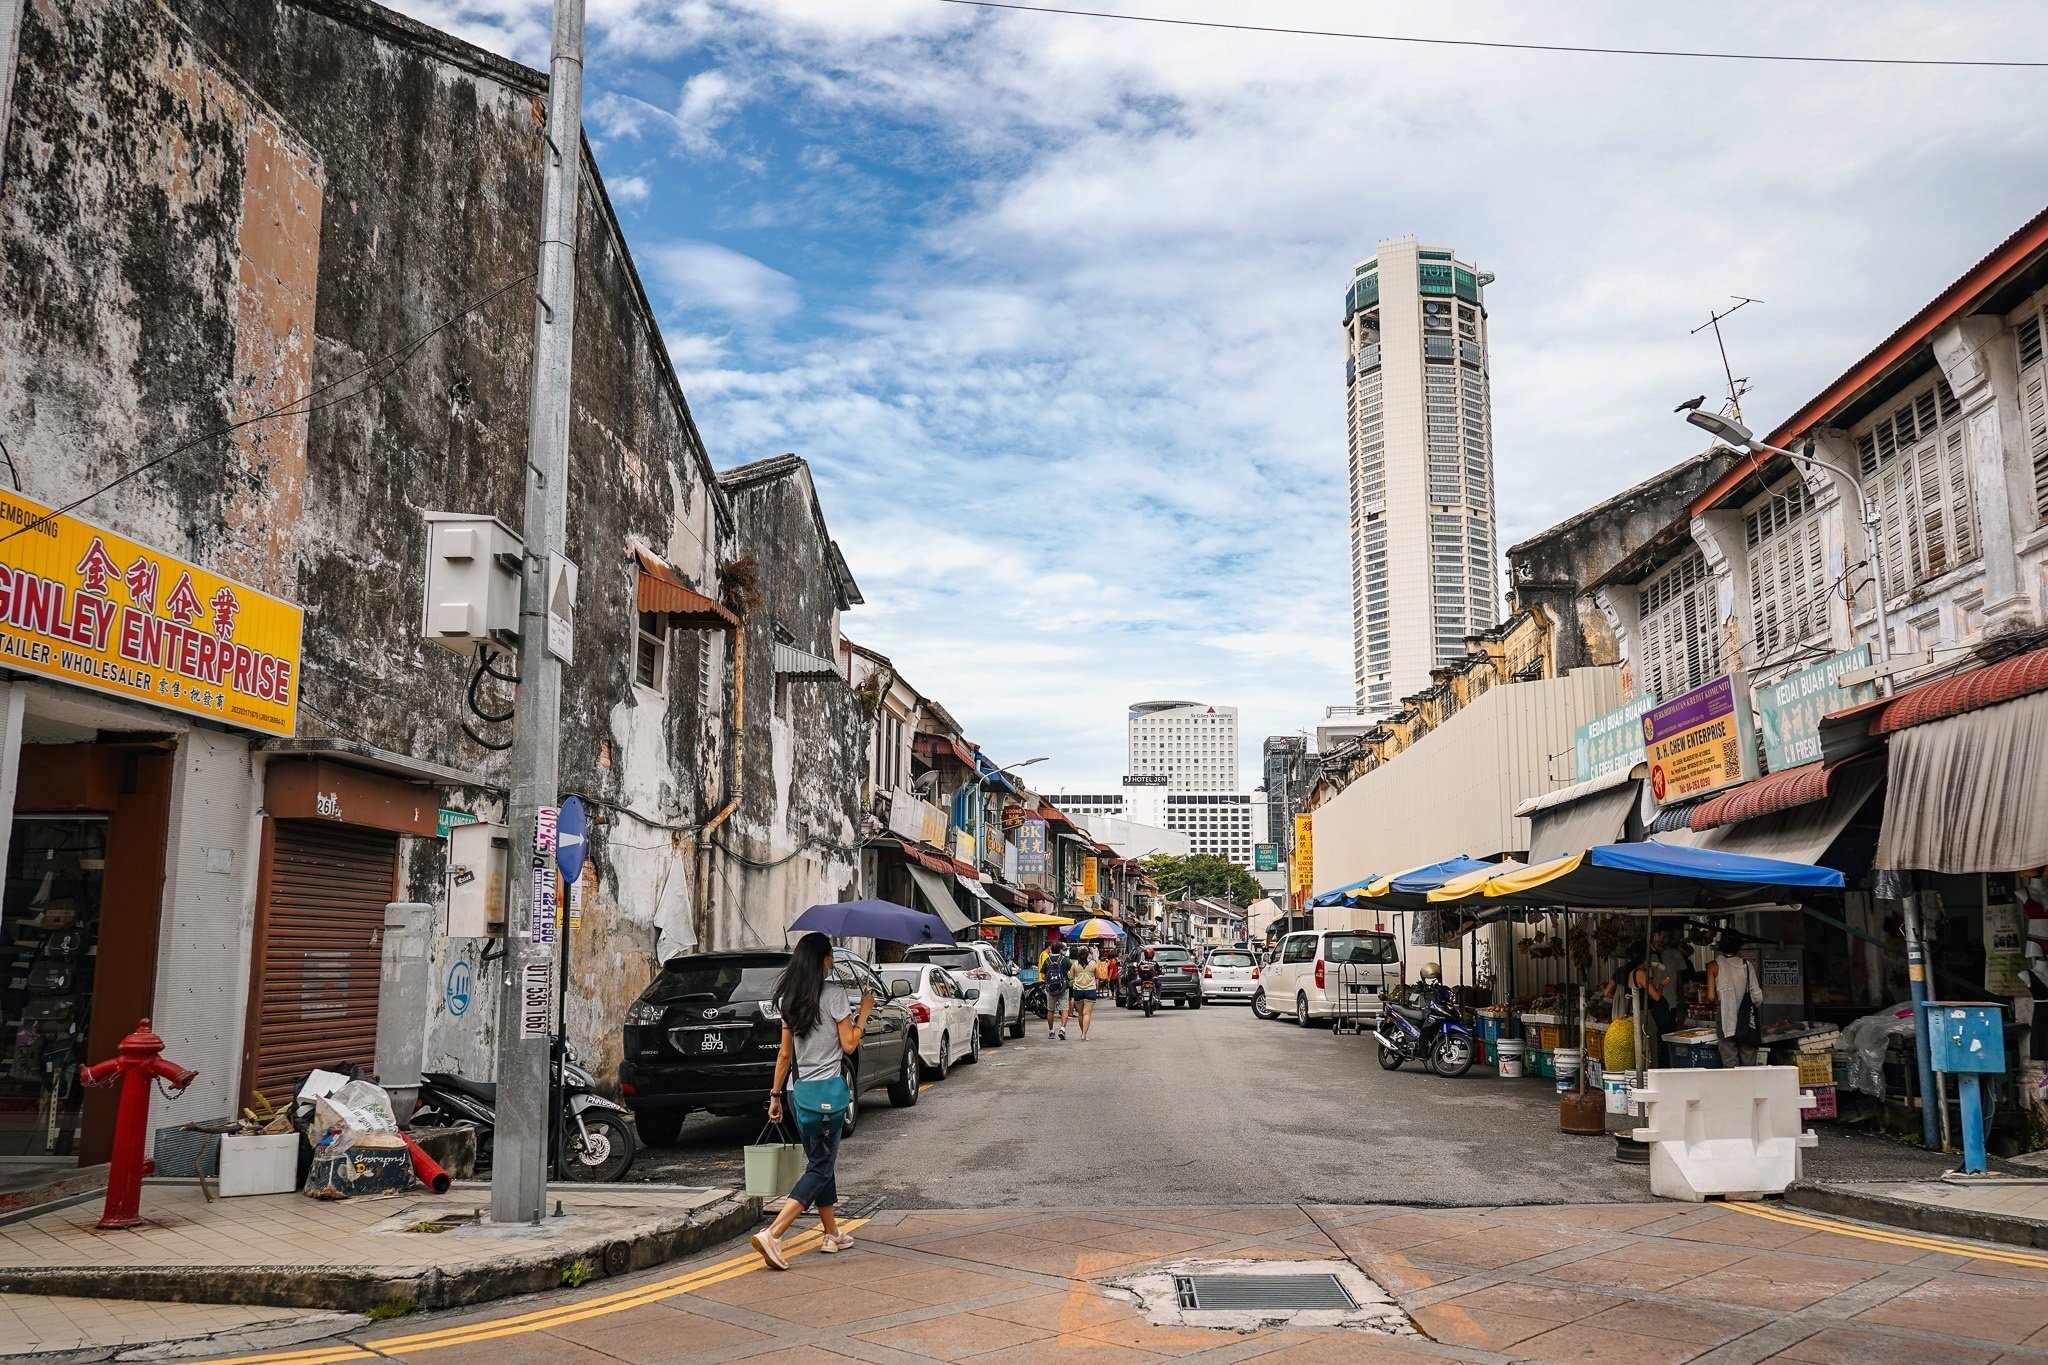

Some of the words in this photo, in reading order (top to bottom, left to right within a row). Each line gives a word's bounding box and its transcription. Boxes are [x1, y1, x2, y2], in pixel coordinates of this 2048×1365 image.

[76, 536, 240, 640] 金利企業
[120, 606, 292, 705] ENTERPRISE
[61, 649, 151, 691] WHOLESALER
[1704, 680, 1730, 699] KOMUNITI
[1775, 679, 1799, 707] KEDAI
[1801, 668, 1825, 697] BUAH
[1589, 718, 1607, 739] KEDAI
[1607, 709, 1624, 731] BUAH
[1625, 697, 1652, 723] BUAHAN
[1669, 735, 1686, 756] CHEW
[1686, 720, 1726, 749] ENTERPRISE
[1020, 825, 1042, 838] BK
[543, 870, 556, 889] 017
[542, 892, 556, 919] 2244
[541, 922, 555, 943] 690
[527, 965, 548, 983] 017
[526, 987, 548, 1006] 536
[525, 1010, 547, 1034] 1667
[704, 1033, 721, 1041] PNJ
